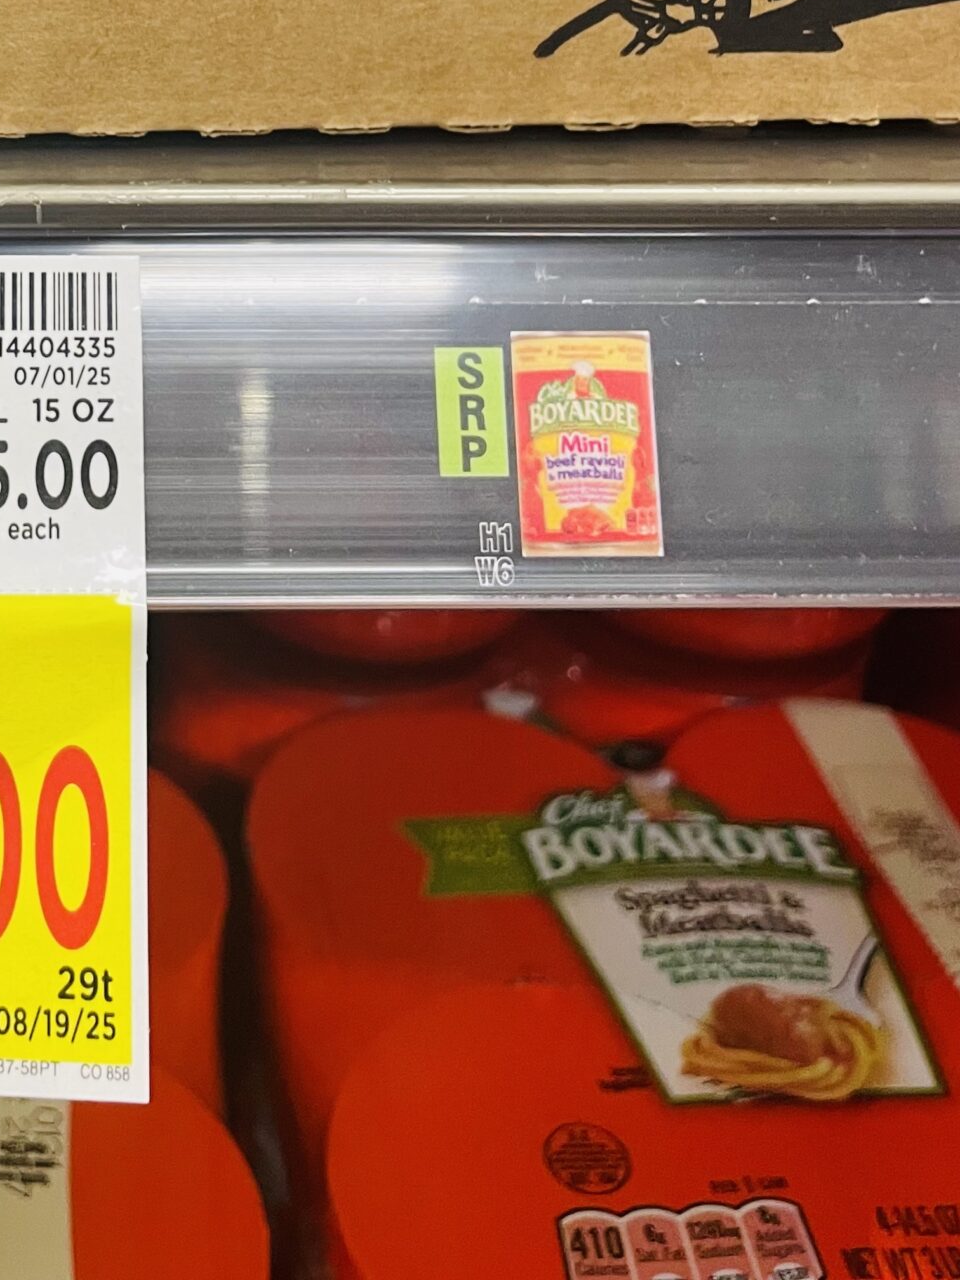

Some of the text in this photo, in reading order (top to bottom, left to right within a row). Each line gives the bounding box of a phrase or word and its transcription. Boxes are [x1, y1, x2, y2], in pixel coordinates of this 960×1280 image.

[13, 366, 112, 388] 07/01/25
[32, 399, 61, 423] 15
[71, 399, 116, 423] OZ
[528, 398, 640, 432] BOYARDEE
[561, 435, 609, 454] Mini
[546, 454, 625, 470] beef ravioli
[7, 517, 61, 540] each
[522, 818, 858, 881] BOYARDEE
[57, 966, 115, 1003] 29t
[80, 1064, 102, 1080] CO
[106, 1065, 131, 1082] 858
